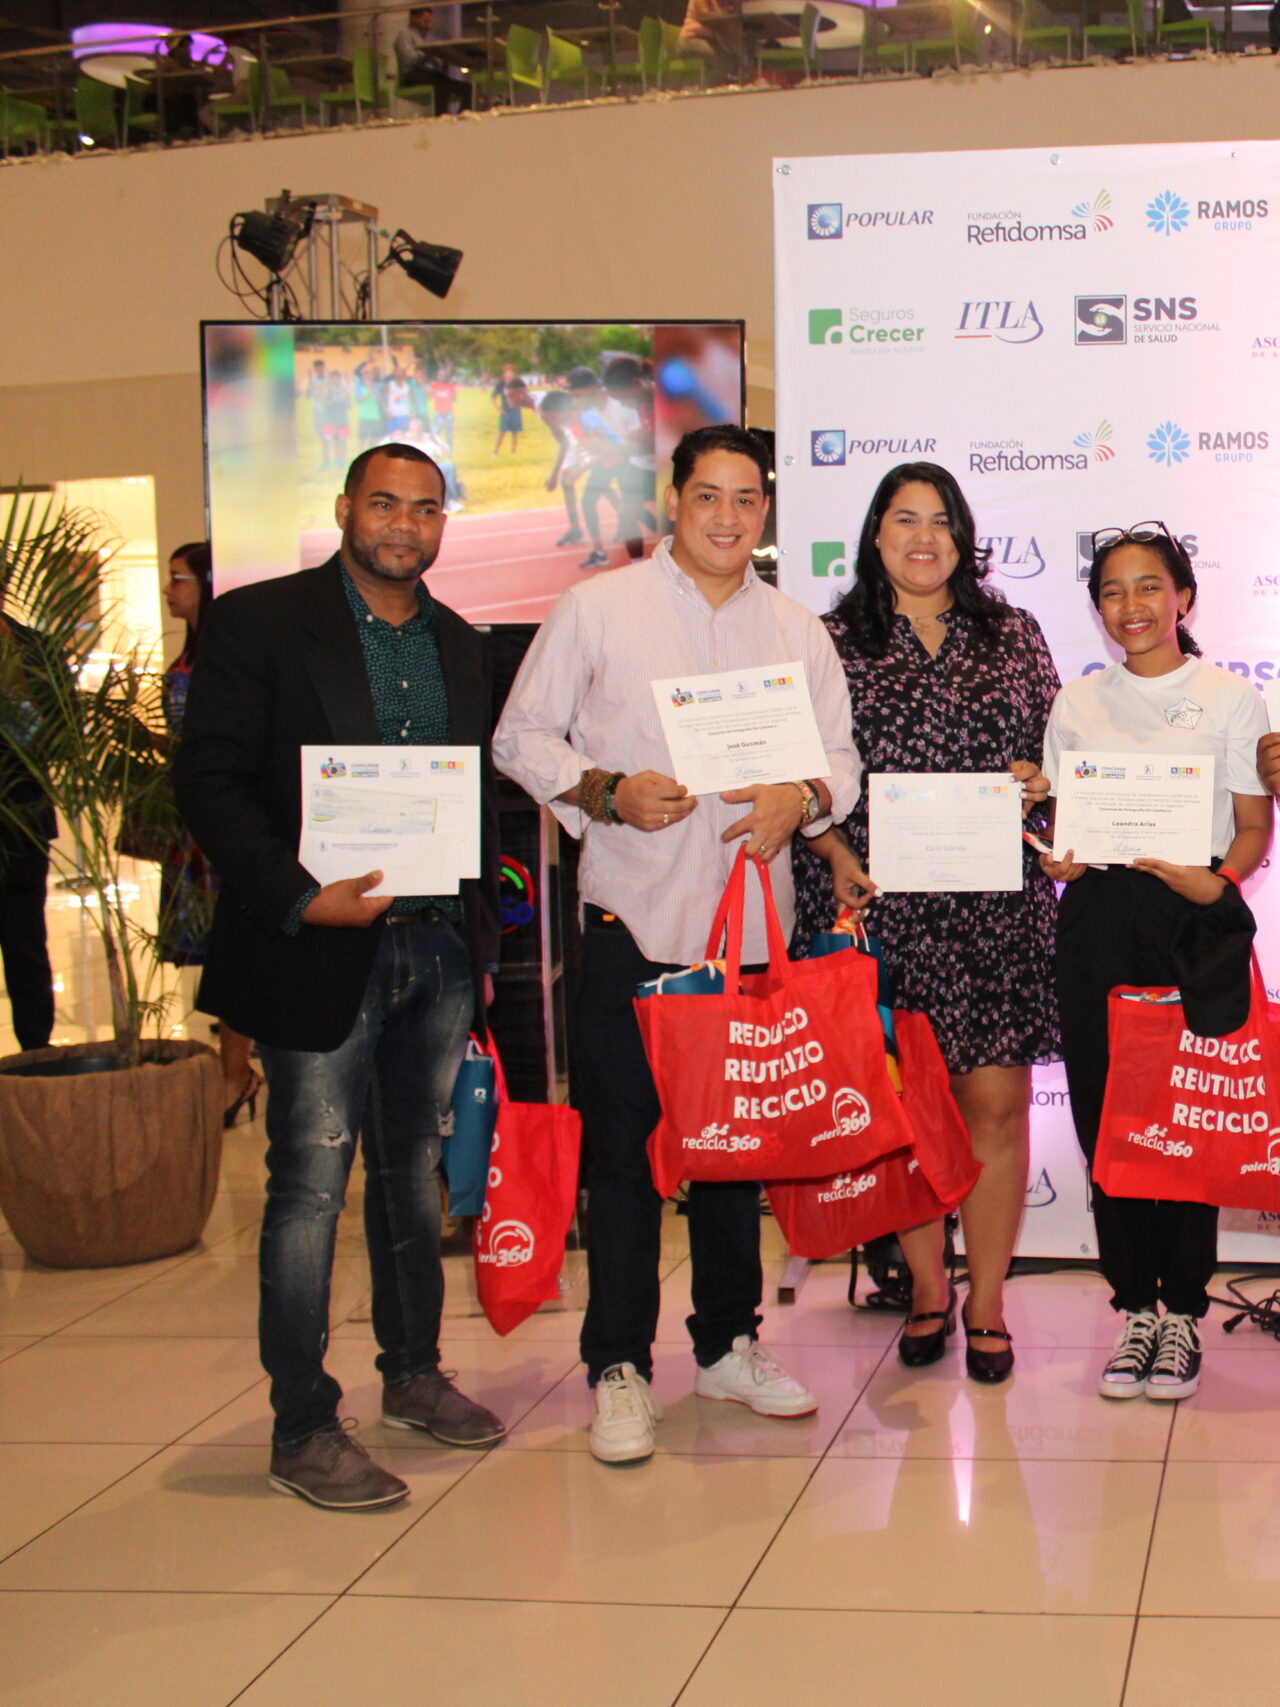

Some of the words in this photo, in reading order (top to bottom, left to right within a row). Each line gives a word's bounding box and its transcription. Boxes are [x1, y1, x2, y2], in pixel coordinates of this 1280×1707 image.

[846, 210, 934, 227] POPULAR
[968, 209, 1021, 221] FUNDACIÓN
[1197, 200, 1268, 219] RAMOS
[967, 221, 1087, 245] Refidomsa
[1214, 221, 1252, 232] GRUPO
[849, 307, 914, 325] Seguros
[1133, 297, 1197, 321] SNS
[955, 300, 1044, 343] ITLA
[1174, 322, 1220, 332] NACIONAL
[849, 324, 925, 343] Crecer
[1134, 335, 1145, 344] DE
[1148, 334, 1178, 343] SALUD
[849, 438, 936, 455] POPULAR
[970, 439, 1023, 449] FUNDACIÓN
[1198, 431, 1269, 450] RAMOS
[969, 450, 1088, 474] Refidomsa
[1215, 452, 1253, 463] GRUPO
[977, 536, 1046, 579] TLA
[734, 1079, 826, 1119] RECICLO
[1172, 1102, 1269, 1134] RECICLO
